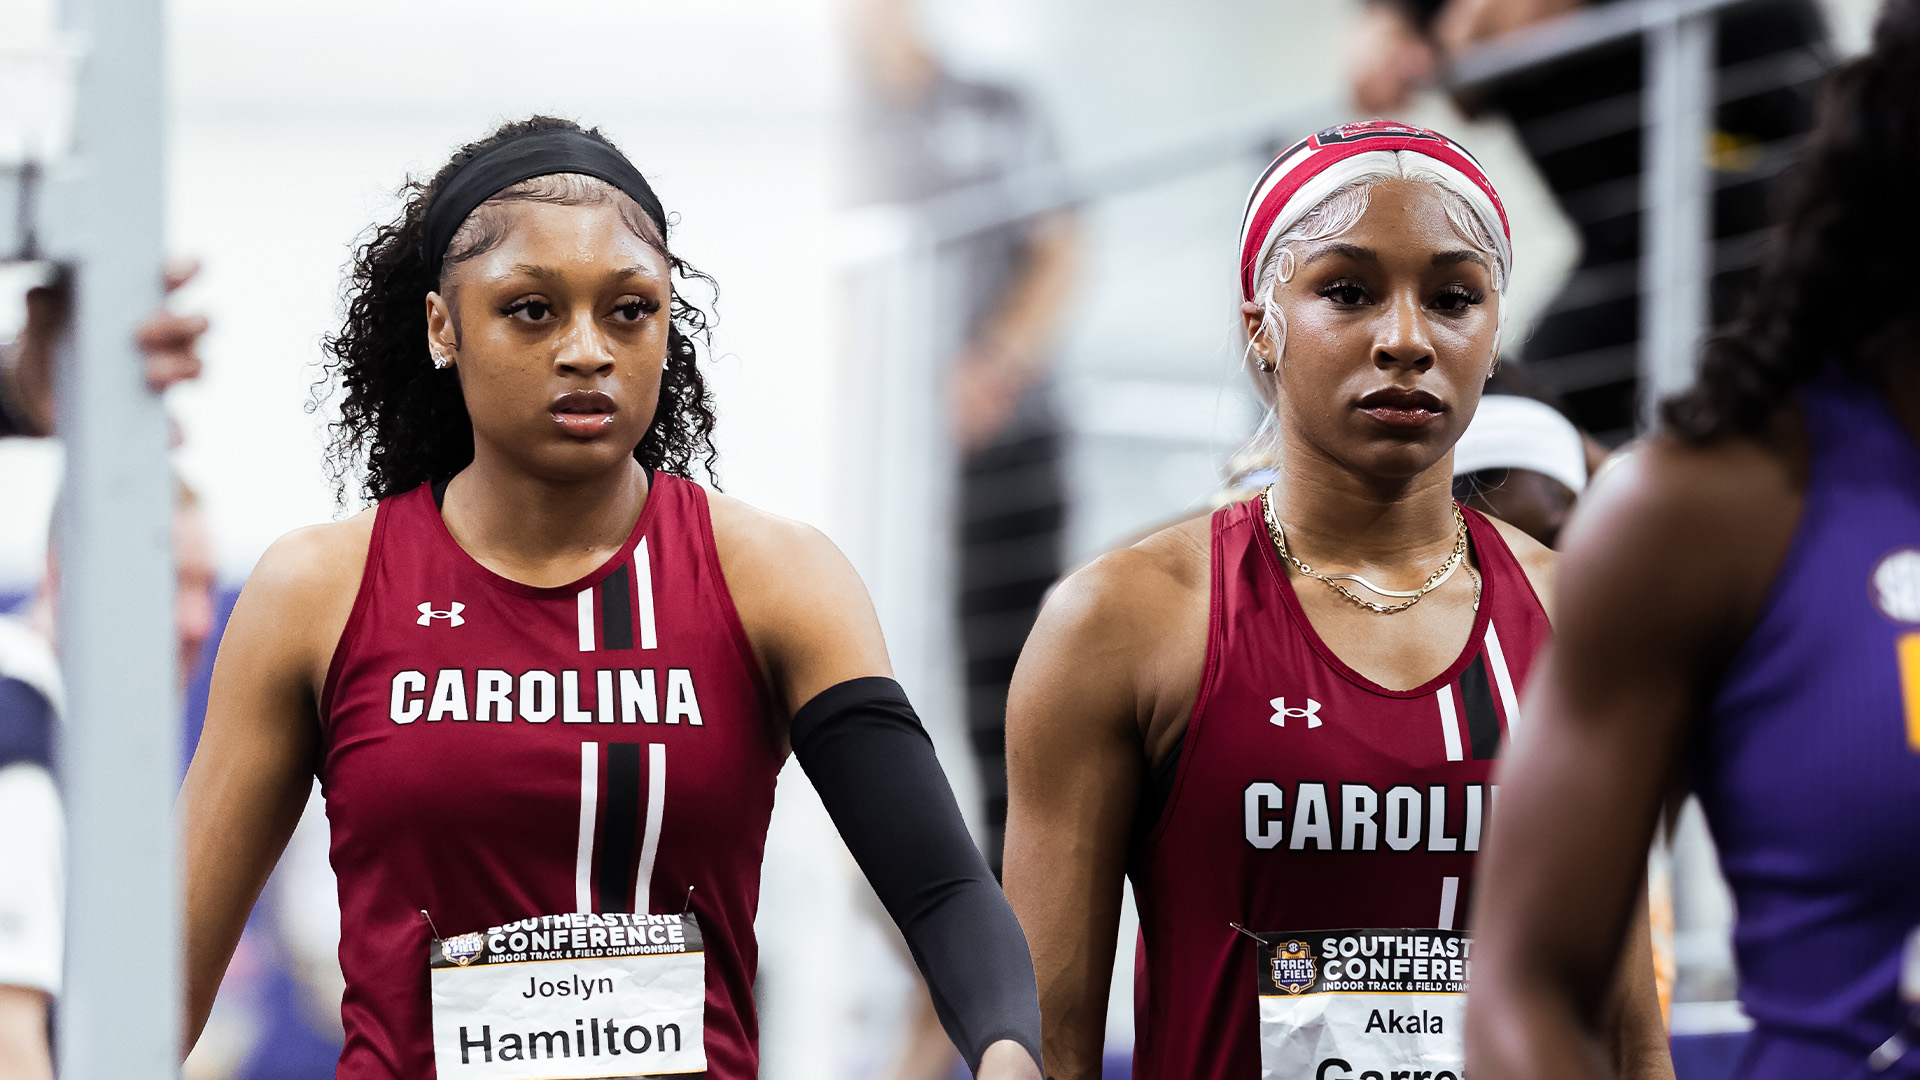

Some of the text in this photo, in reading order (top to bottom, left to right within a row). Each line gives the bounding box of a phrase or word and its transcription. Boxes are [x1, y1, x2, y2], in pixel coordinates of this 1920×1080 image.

[389, 668, 704, 726] CAROLINA
[1243, 781, 1500, 852] CAROLI
[488, 924, 686, 954] CONFERENCE
[1321, 936, 1475, 959] SOUTHEAST
[488, 952, 527, 964] INDOOR
[530, 950, 563, 961] TRACK
[565, 949, 573, 959] &
[575, 948, 603, 958] FIELD
[606, 943, 686, 957] CHAMPIONSHIPS
[1273, 959, 1314, 970] TRACK
[1273, 969, 1315, 980] & FIELD
[1322, 981, 1364, 992] INDOOR
[1367, 981, 1403, 992] TRACK
[1406, 981, 1413, 991] &
[1415, 981, 1442, 992] FIELD
[522, 974, 614, 1001] Joslyn
[1364, 1009, 1444, 1034] Akala
[459, 1017, 681, 1065] Hamilton
